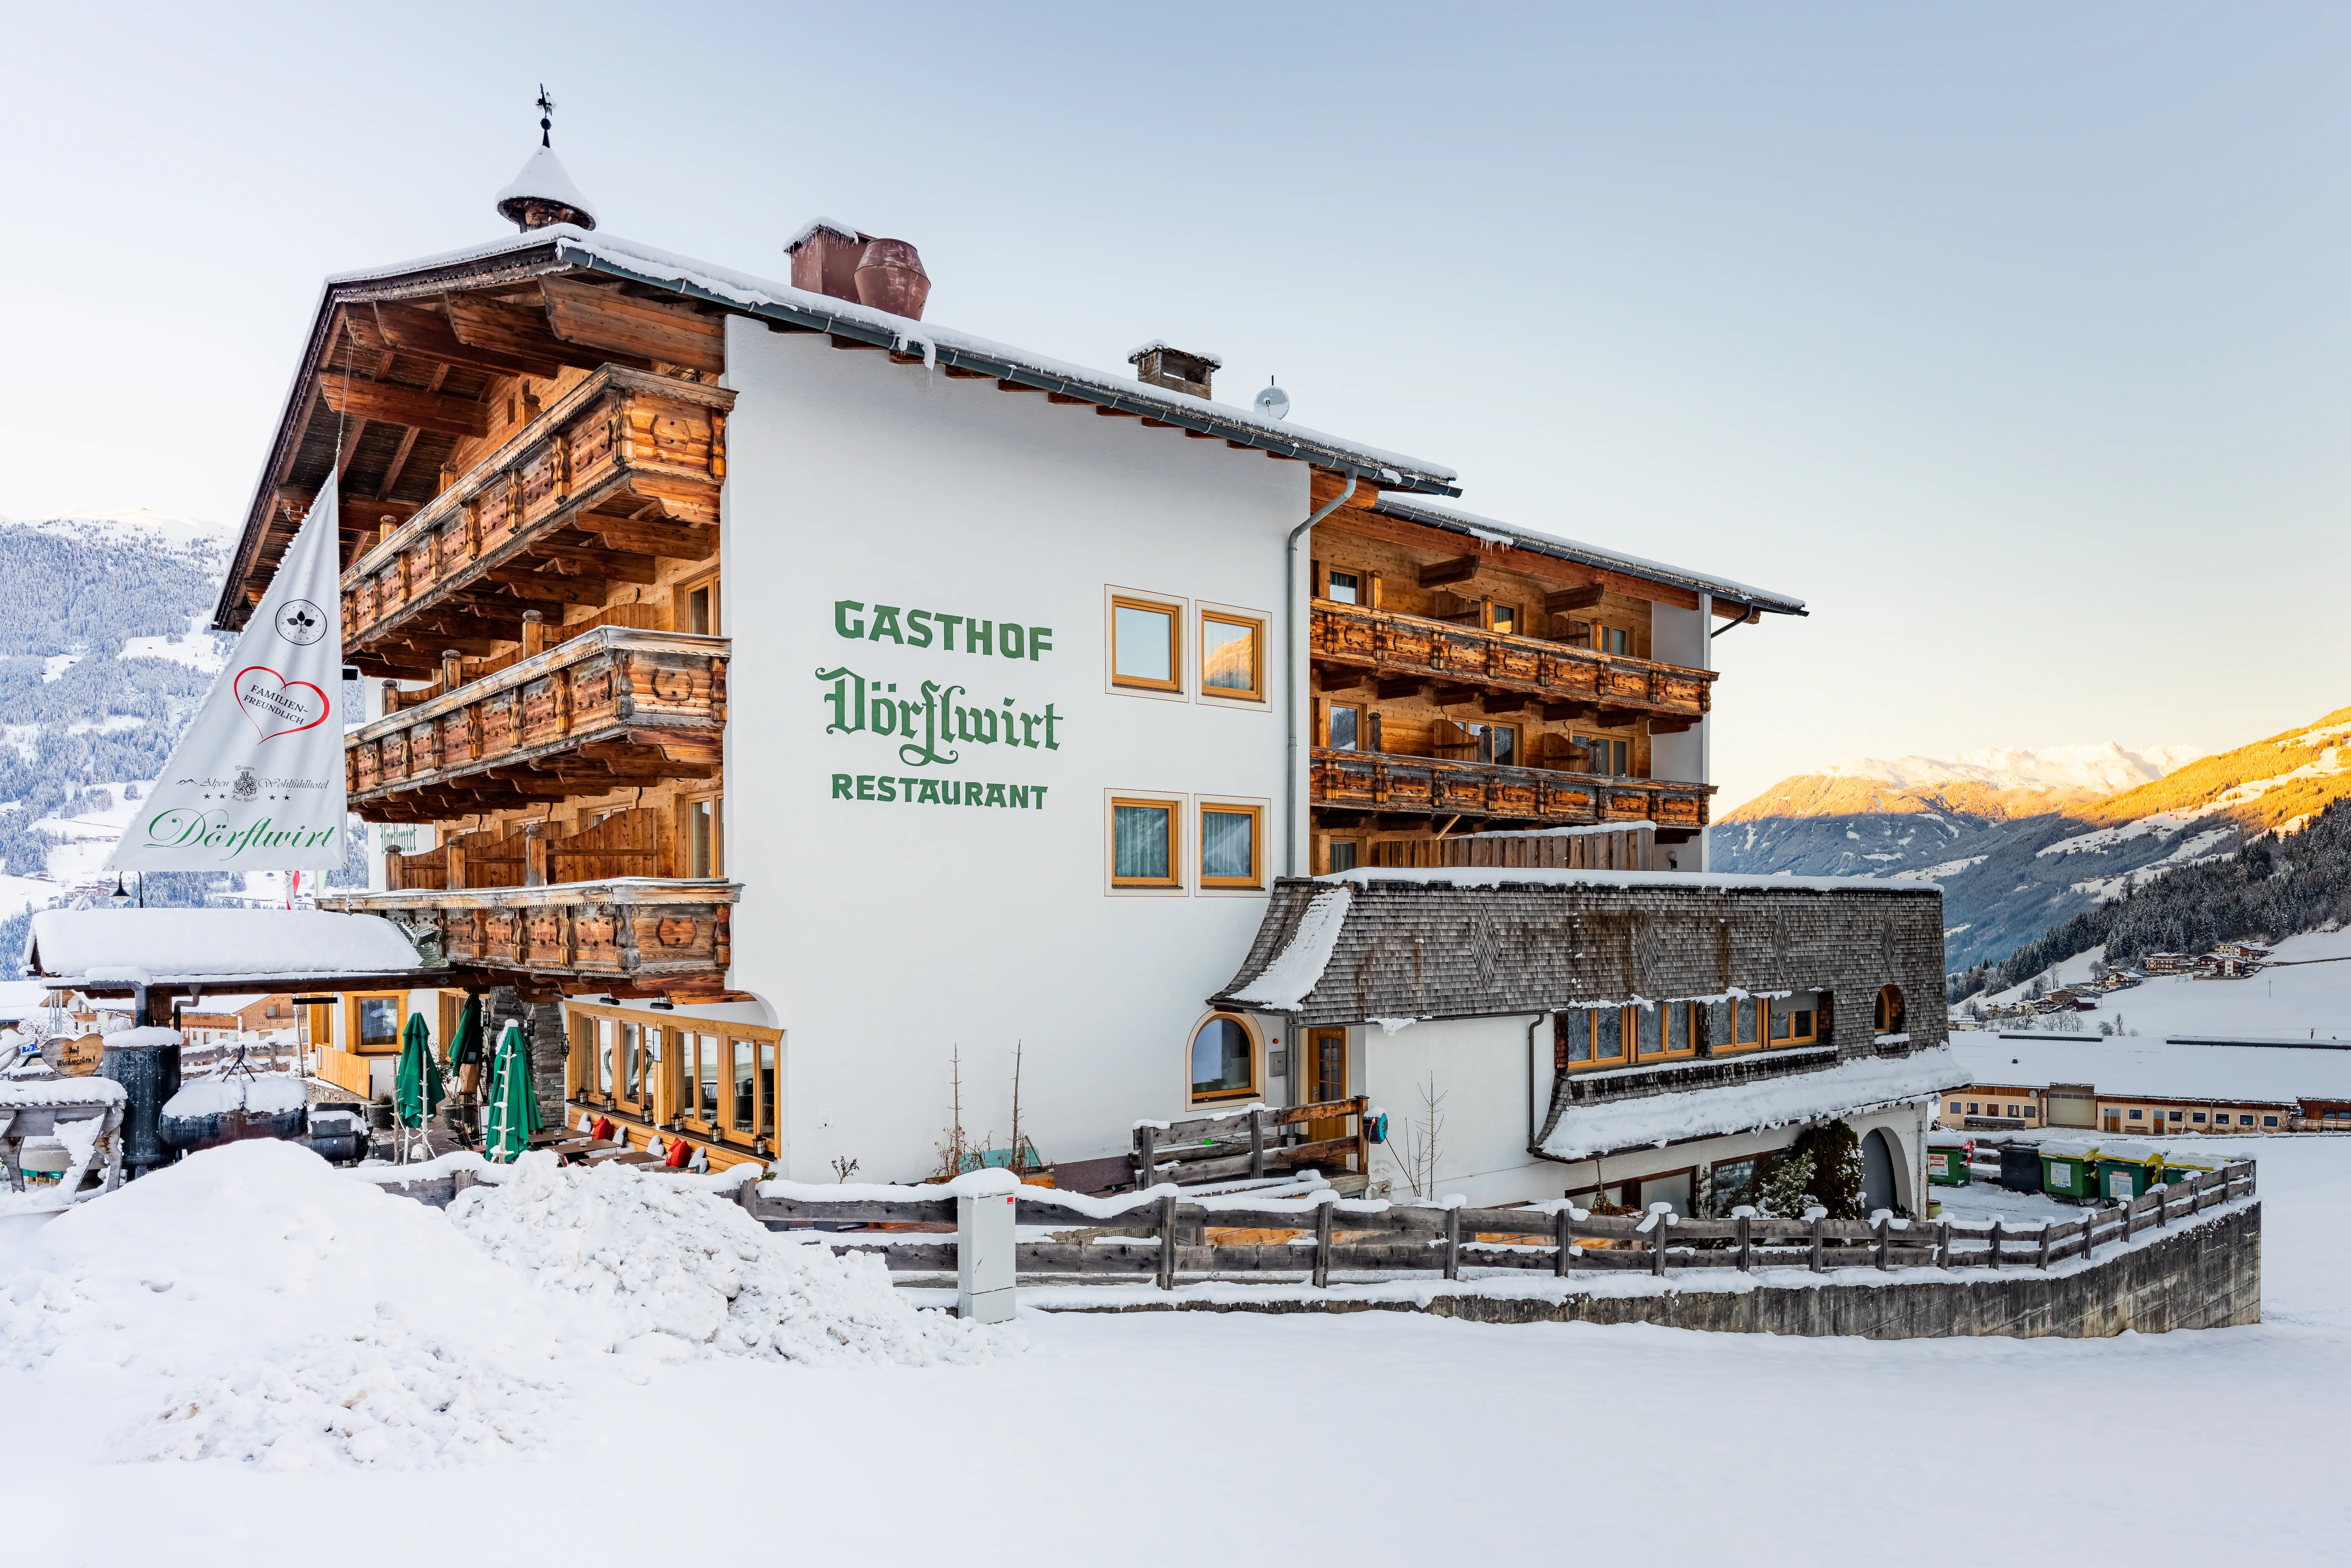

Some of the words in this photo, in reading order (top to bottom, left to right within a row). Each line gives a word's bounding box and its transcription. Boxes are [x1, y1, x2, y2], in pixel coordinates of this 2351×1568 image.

[283, 604, 319, 618] TIROLER
[835, 600, 1052, 661] GASTHOF
[243, 694, 305, 725] FREUNDLICH
[250, 685, 308, 713] FAMILIEN-
[815, 667, 1063, 766] Dörflwirt
[199, 778, 229, 790] Alpen
[258, 778, 329, 791] Wohlfühlhotel
[832, 774, 1048, 809] RESTAURANT
[143, 808, 337, 861] Dörflwirt
[69, 1046, 79, 1055] Auf
